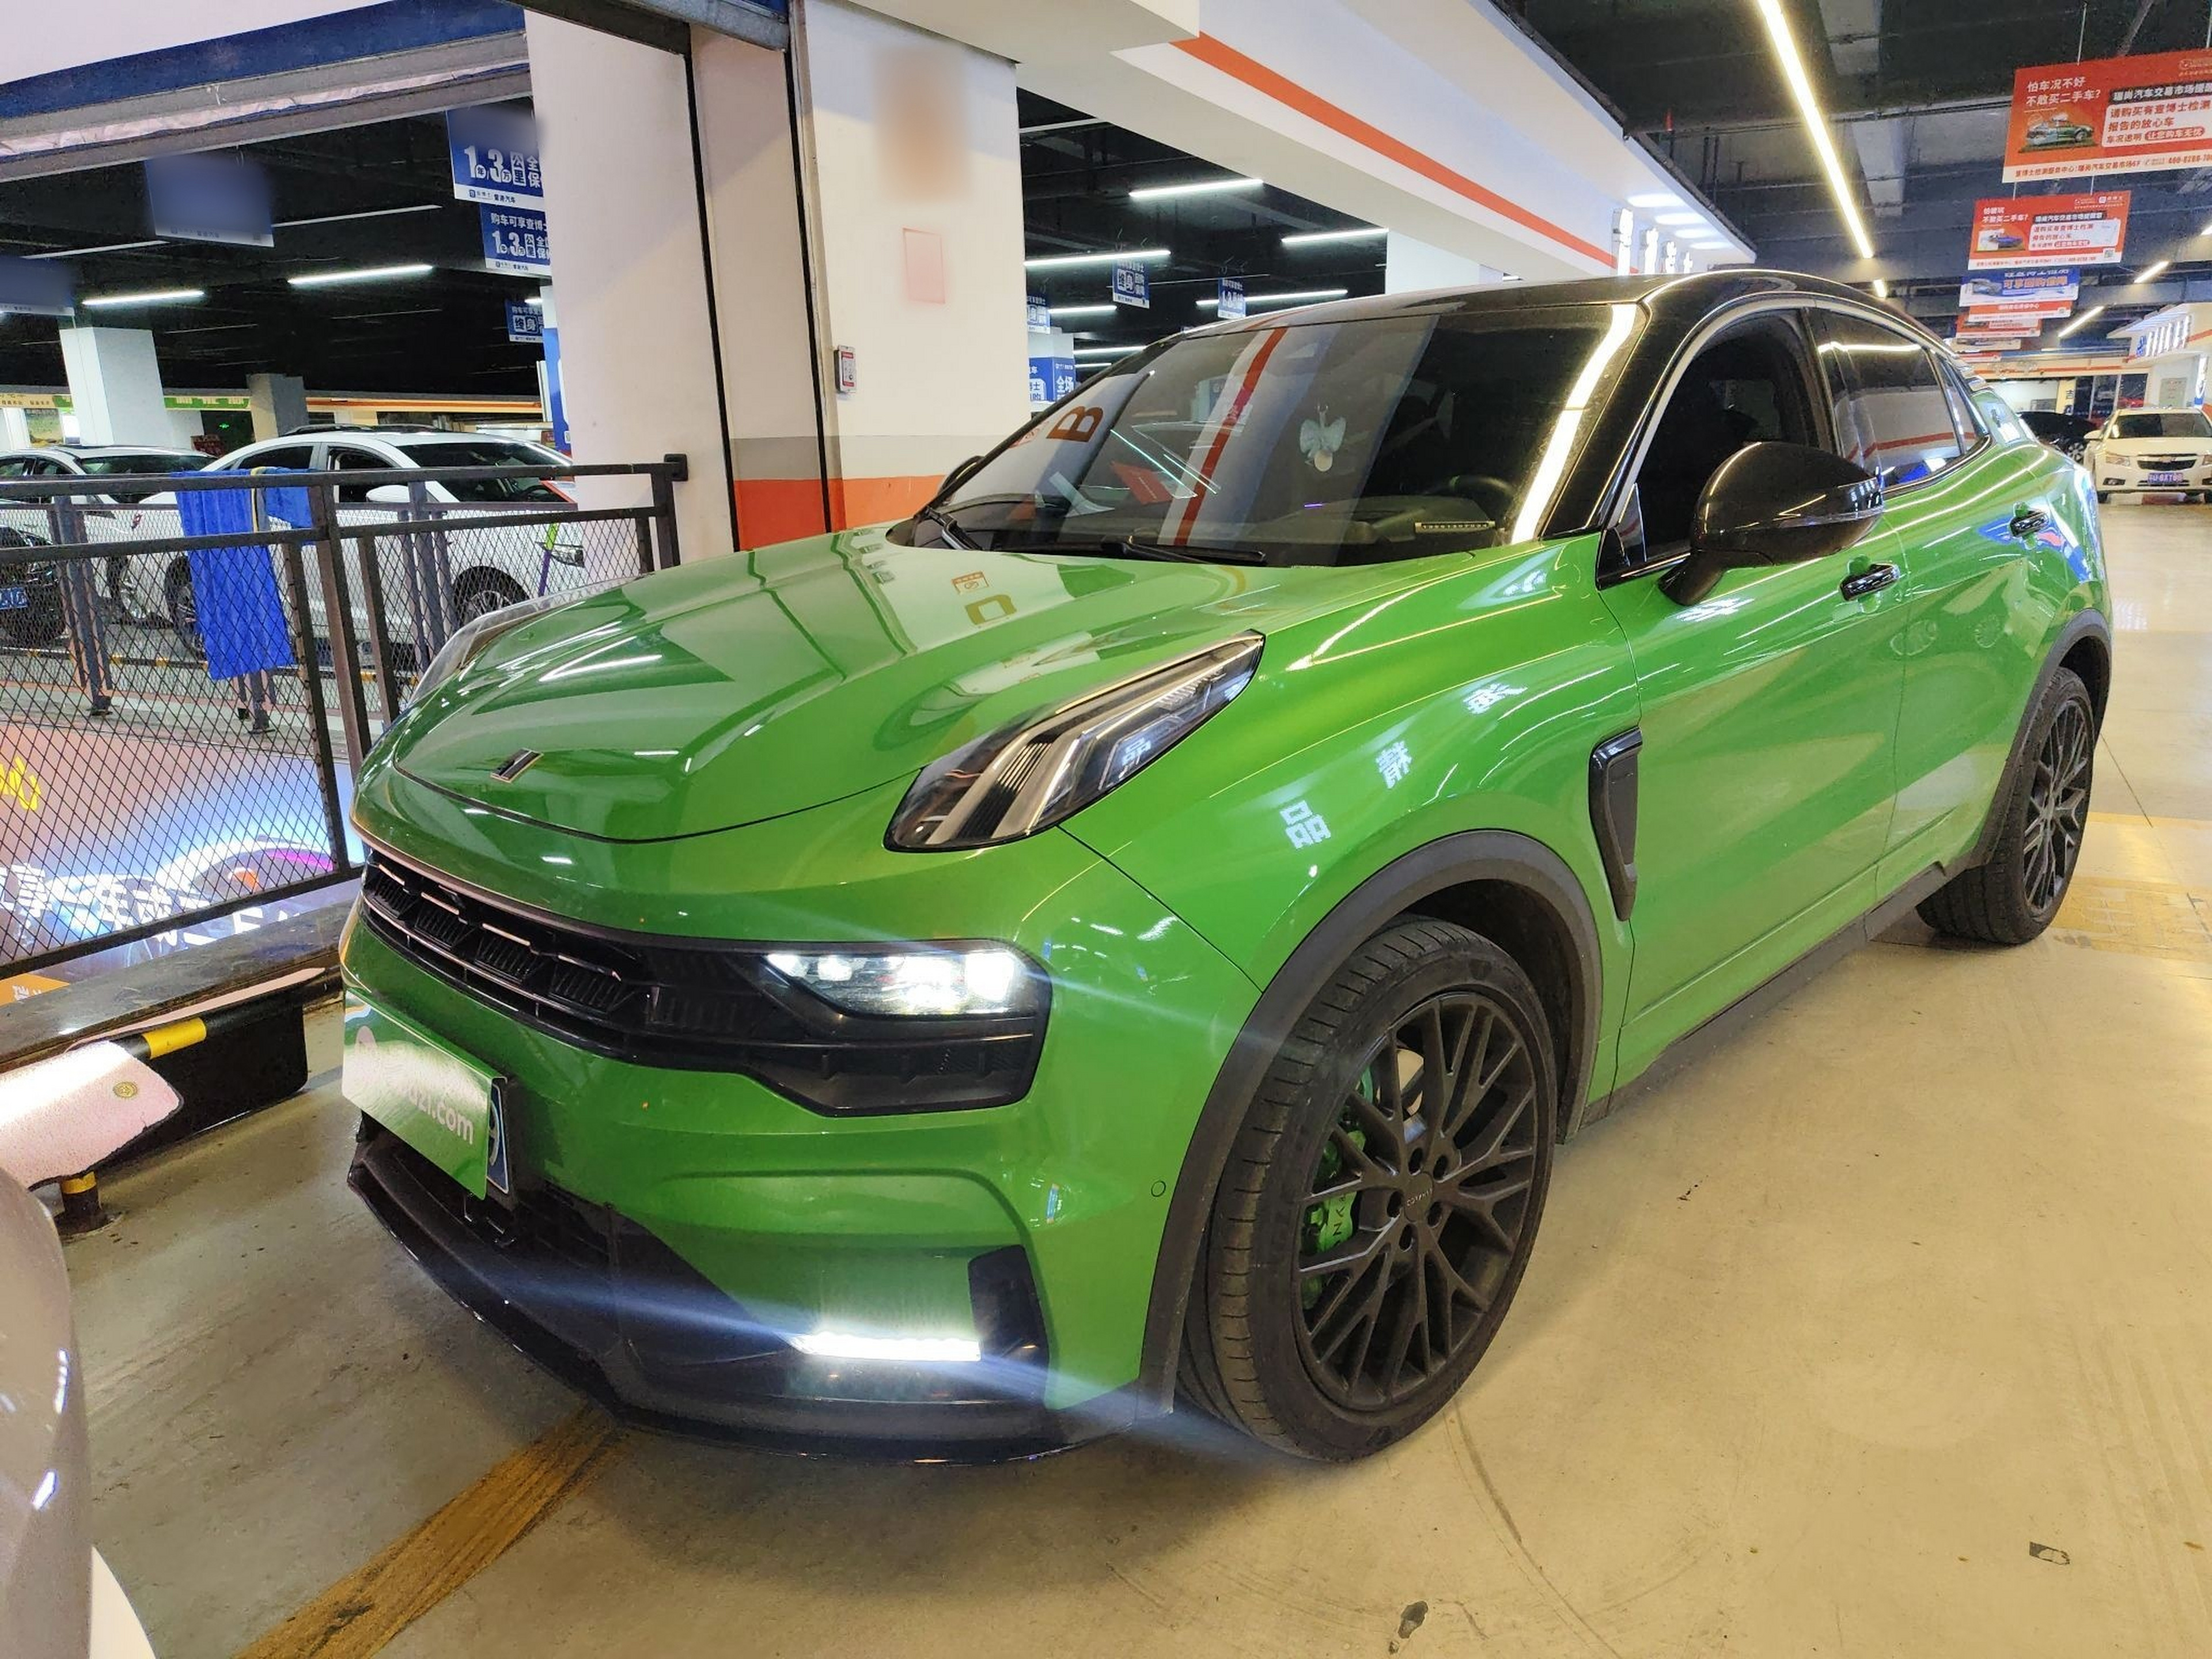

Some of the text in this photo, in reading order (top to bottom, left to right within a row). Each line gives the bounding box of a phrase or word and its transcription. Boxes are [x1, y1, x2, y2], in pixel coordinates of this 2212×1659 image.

[2027, 77, 2086, 92] 怕车况不好
[2108, 116, 2174, 132] 报告的放心车
[1056, 376, 1074, 393] 全场
